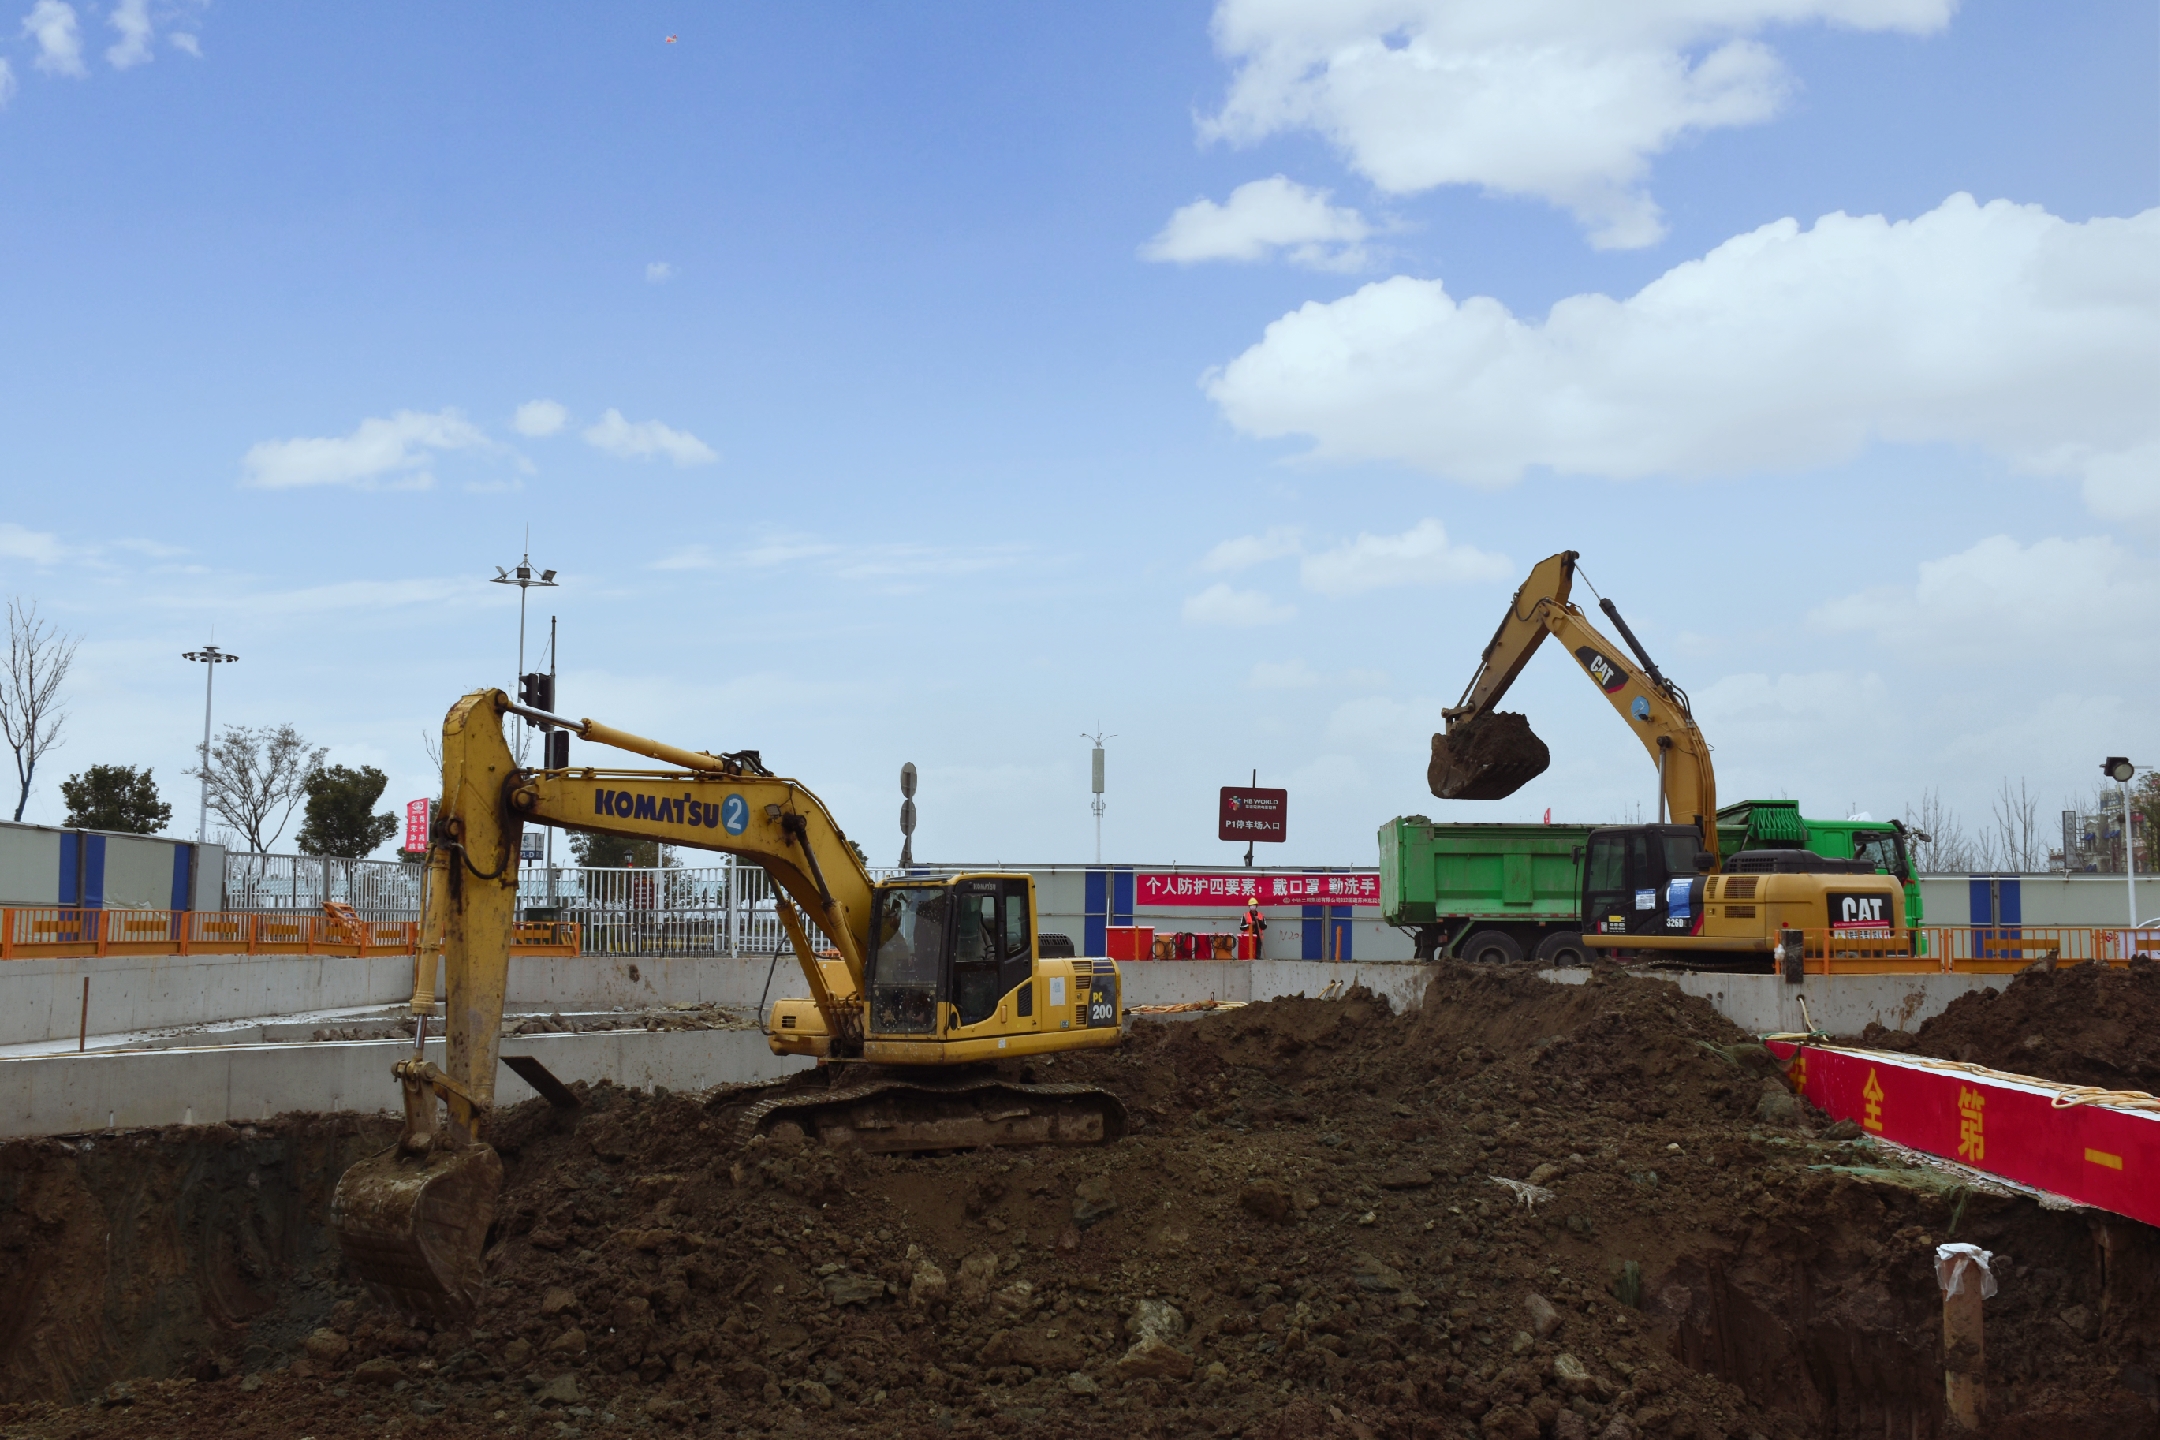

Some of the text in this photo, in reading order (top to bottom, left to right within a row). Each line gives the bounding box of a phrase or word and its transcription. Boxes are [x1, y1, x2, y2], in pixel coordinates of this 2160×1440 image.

[1590, 655, 1614, 686] CAT
[595, 789, 742, 830] KOMATSU 2
[1225, 820, 1280, 830] P1停车场入口
[1272, 878, 1320, 896] 戴口罩
[1328, 877, 1376, 896] 勤洗手
[1842, 896, 1883, 922] CAT
[1092, 992, 1103, 1003] PC
[1093, 1004, 1113, 1019] 200
